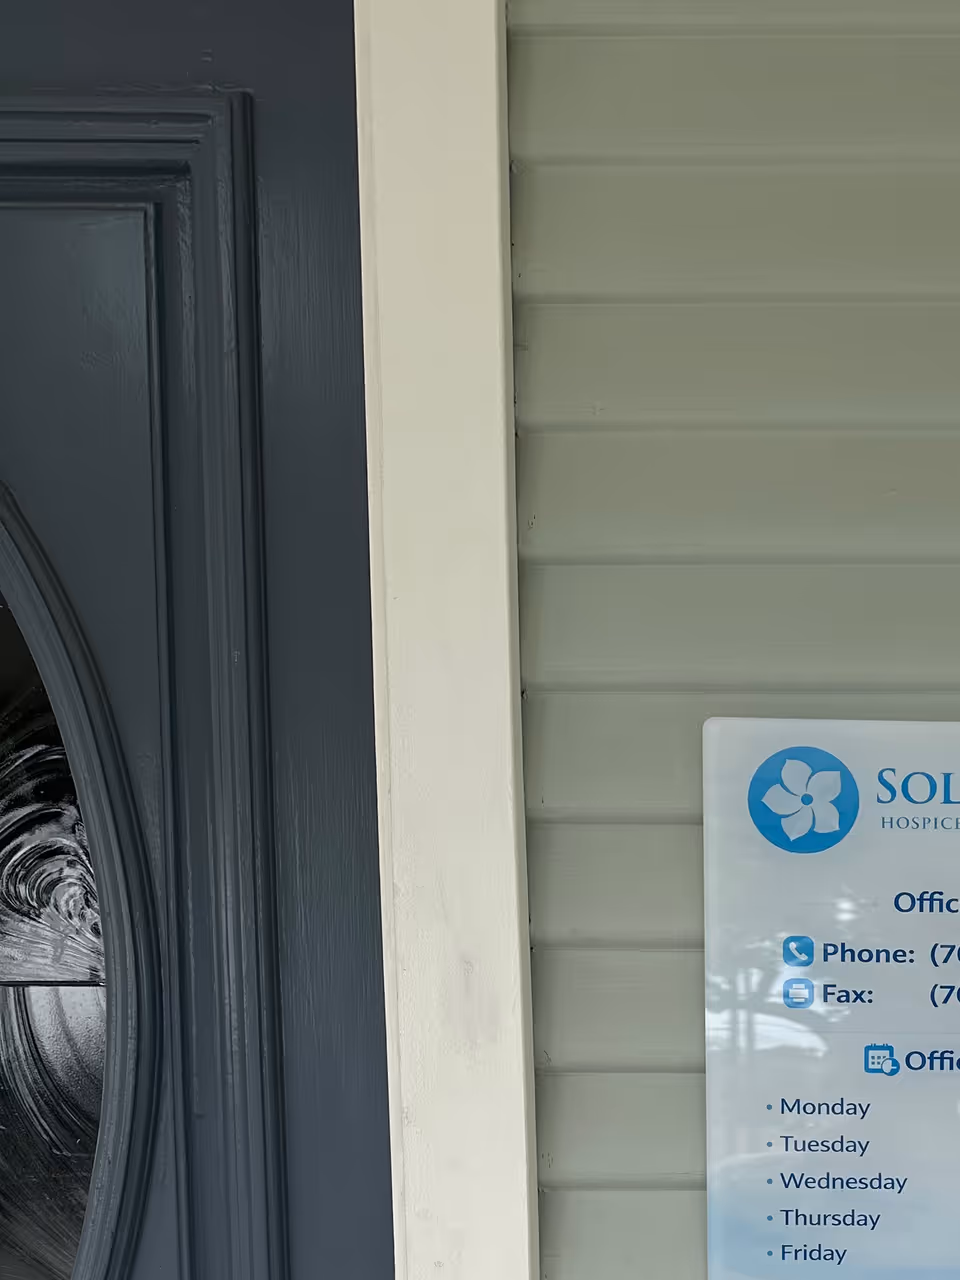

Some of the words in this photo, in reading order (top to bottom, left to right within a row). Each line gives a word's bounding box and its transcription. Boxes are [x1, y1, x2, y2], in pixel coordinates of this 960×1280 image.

[823, 942, 915, 964] Phone:
[823, 984, 873, 1004] Fax:
[780, 1097, 871, 1120] Monday
[779, 1135, 870, 1157] Tuesday
[780, 1171, 908, 1194] Wednesday
[779, 1208, 881, 1231] Thursday
[781, 1243, 848, 1266] Friday
